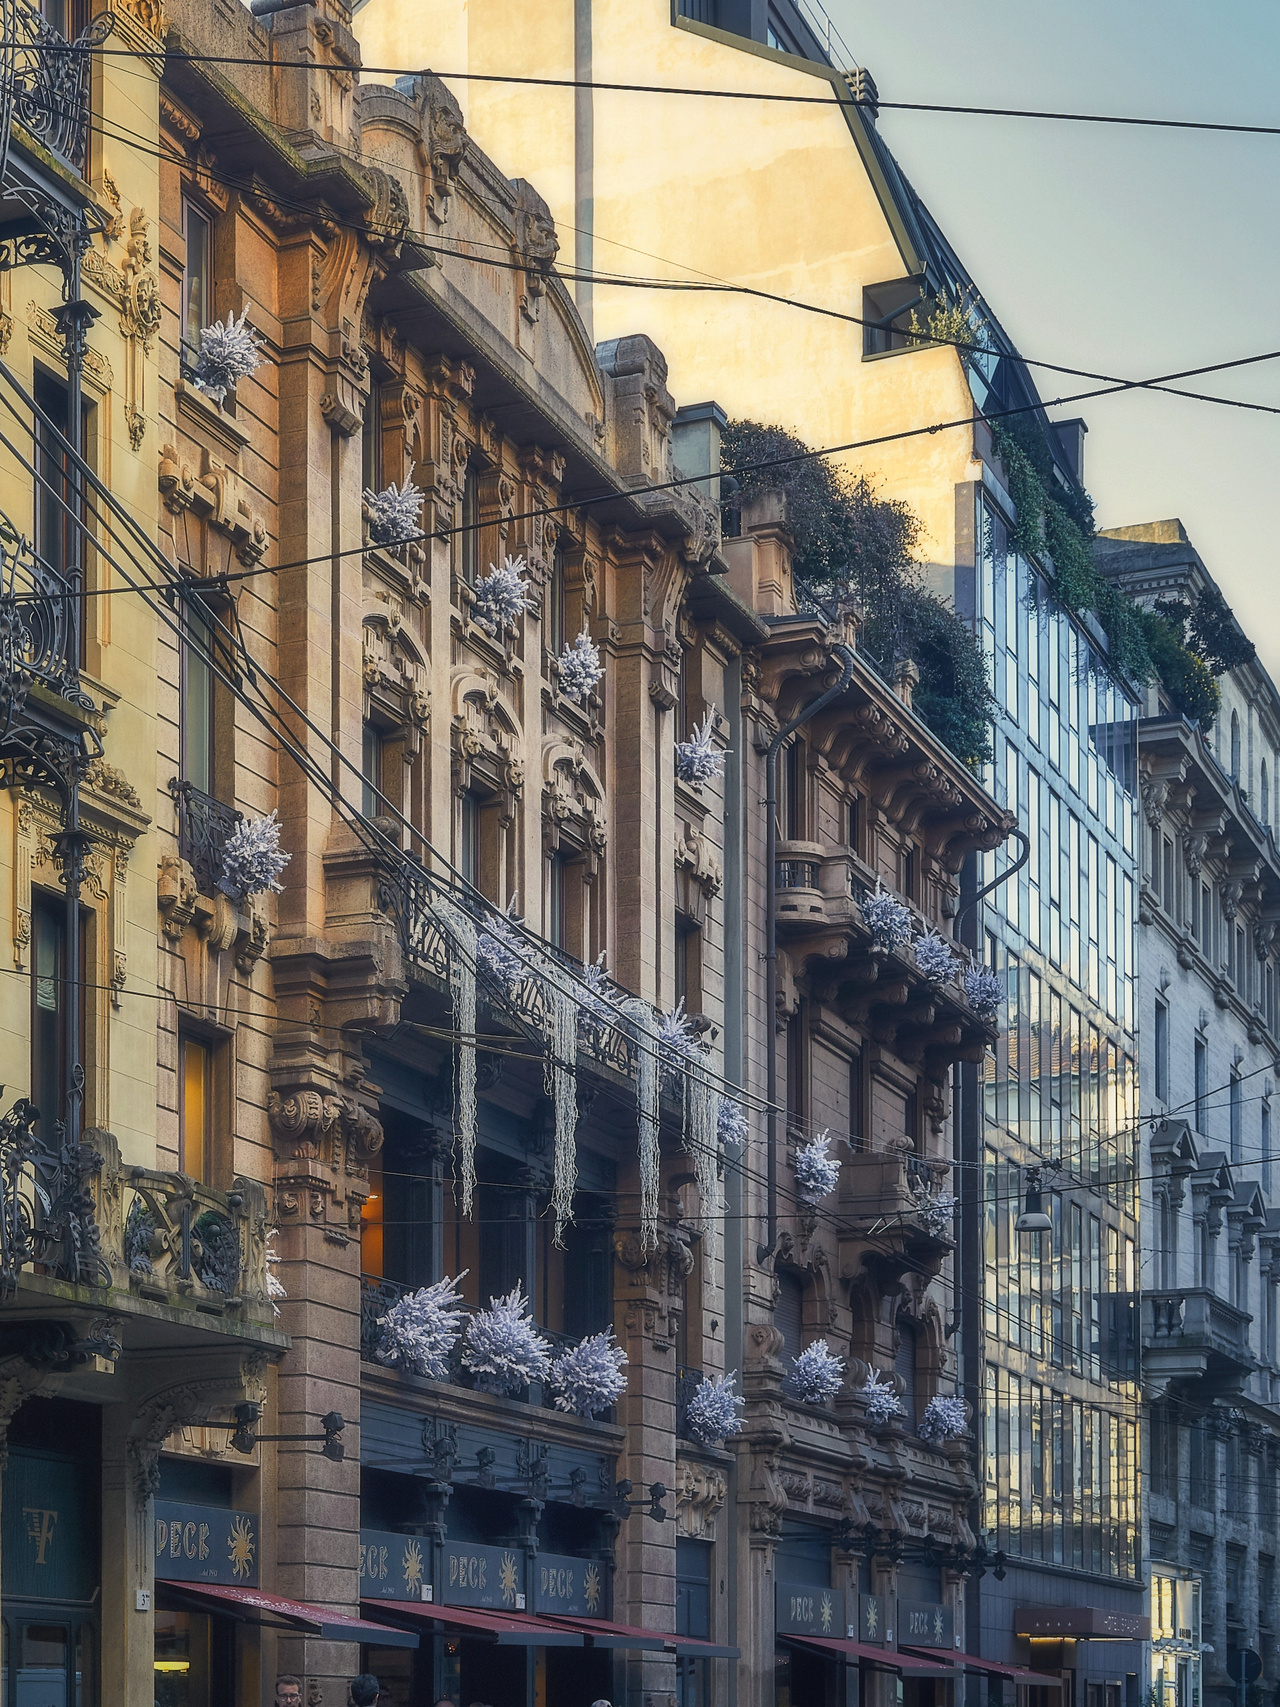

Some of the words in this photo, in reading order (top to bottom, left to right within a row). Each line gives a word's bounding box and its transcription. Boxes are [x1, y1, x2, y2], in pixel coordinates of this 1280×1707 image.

[156, 1519, 210, 1561] PECK
[359, 1544, 389, 1580] ECK
[449, 1555, 487, 1590] PECK
[540, 1566, 574, 1599] PECK
[790, 1596, 814, 1622] PECK
